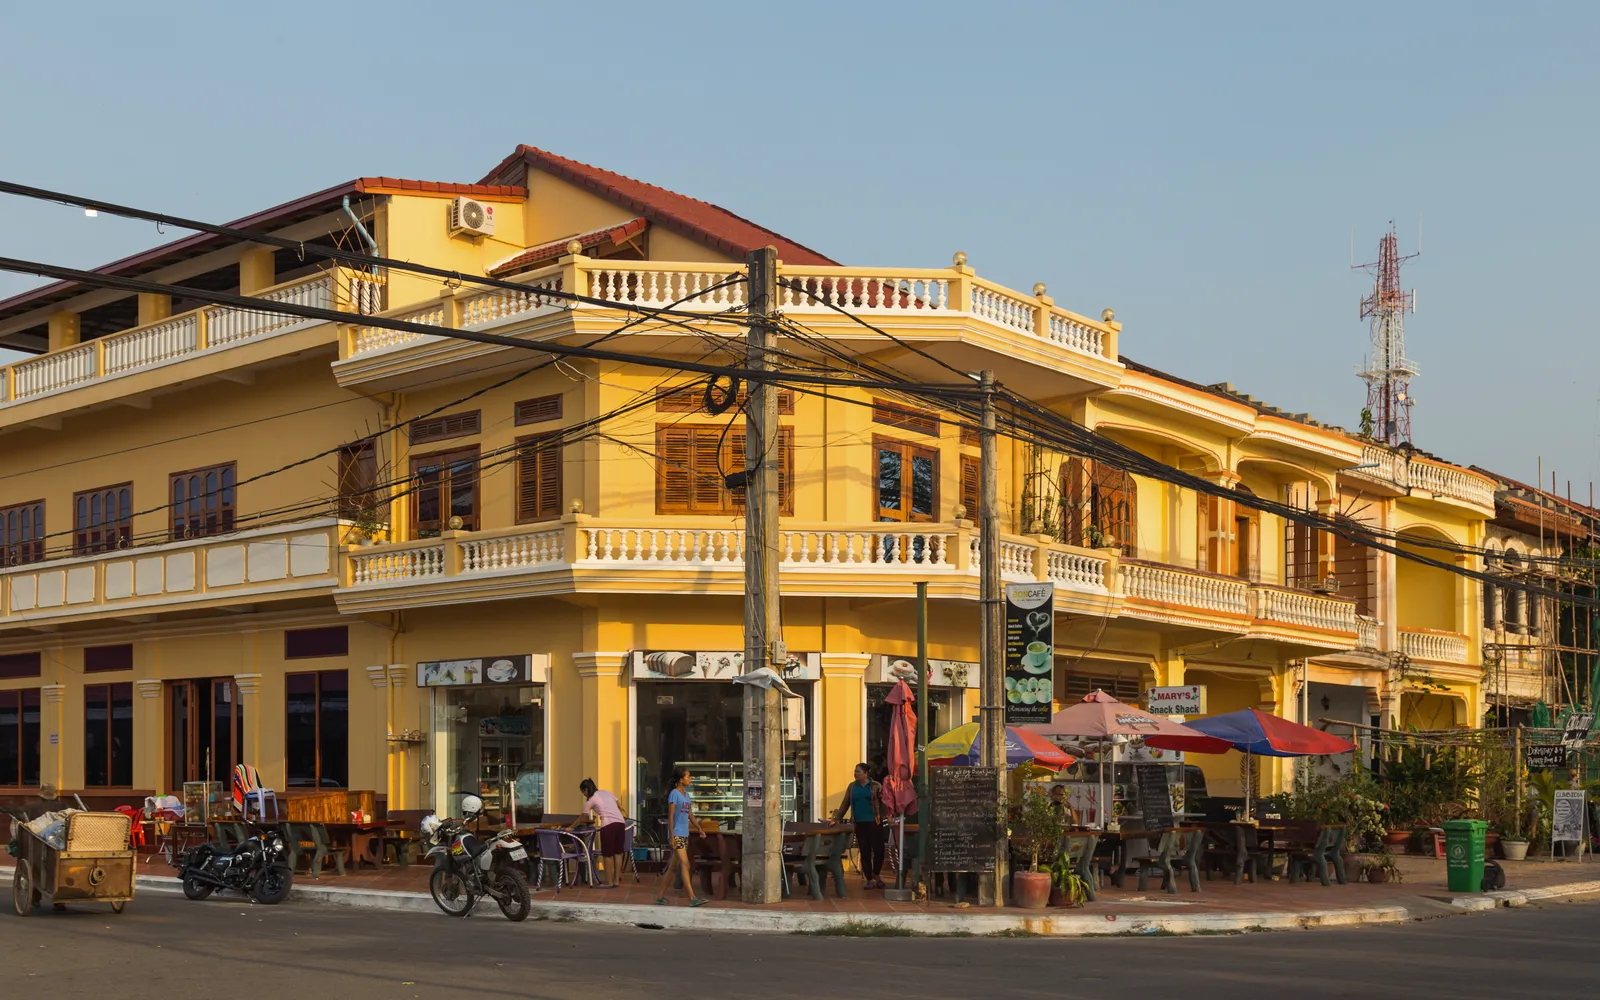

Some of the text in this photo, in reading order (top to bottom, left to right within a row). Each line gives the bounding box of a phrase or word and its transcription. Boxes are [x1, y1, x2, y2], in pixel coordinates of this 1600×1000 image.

[1012, 588, 1046, 598] BONCAFÉ
[1157, 692, 1191, 700] MARY'S
[1150, 704, 1199, 714] Snack Shack
